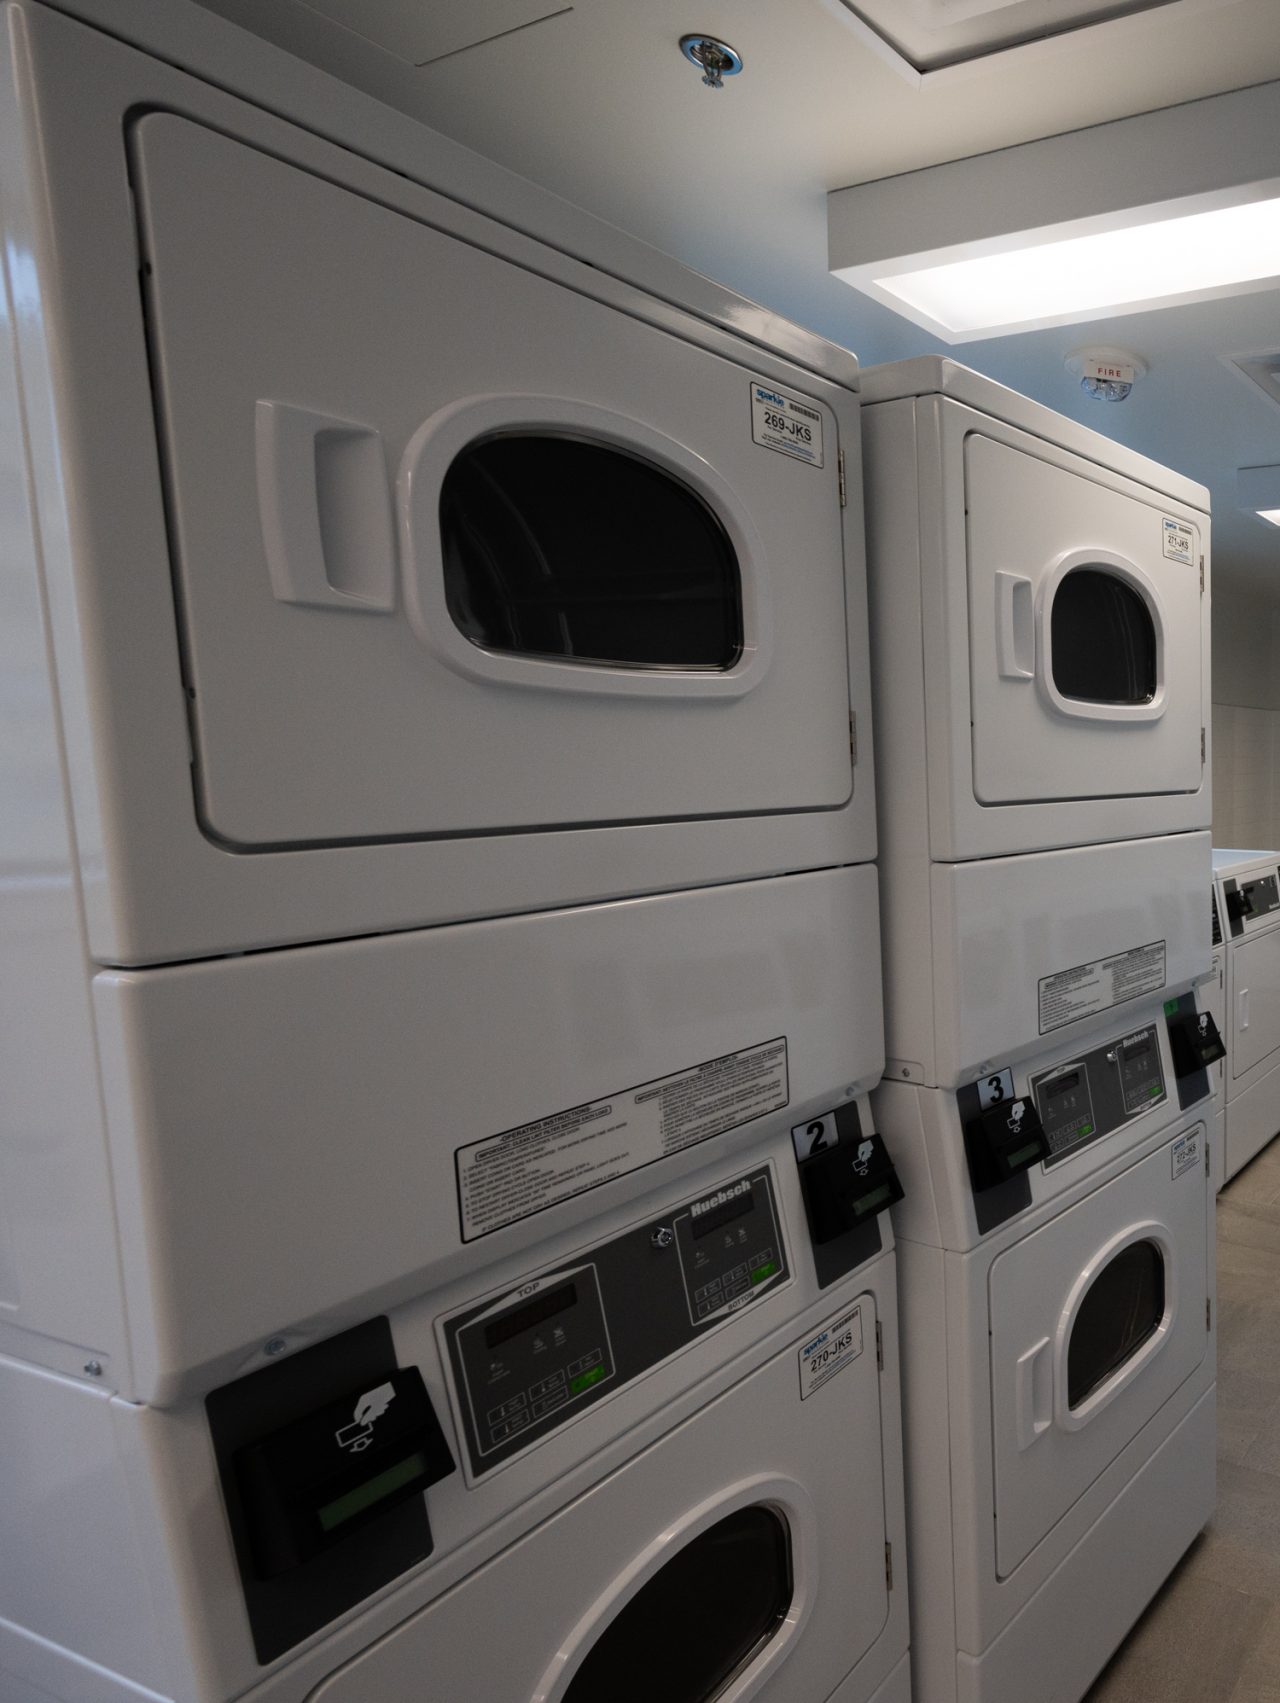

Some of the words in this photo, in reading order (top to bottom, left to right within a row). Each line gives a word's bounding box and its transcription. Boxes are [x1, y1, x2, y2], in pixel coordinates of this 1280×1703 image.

[1097, 367, 1122, 378] FIRE
[764, 411, 812, 442] 269-JKS
[988, 1075, 1005, 1104] 3
[806, 1121, 828, 1155] 2
[690, 1179, 753, 1218] Huebsch
[517, 1281, 541, 1299] TOP
[727, 1290, 755, 1312] BOTTOM
[810, 1331, 853, 1373] 270-JKS
